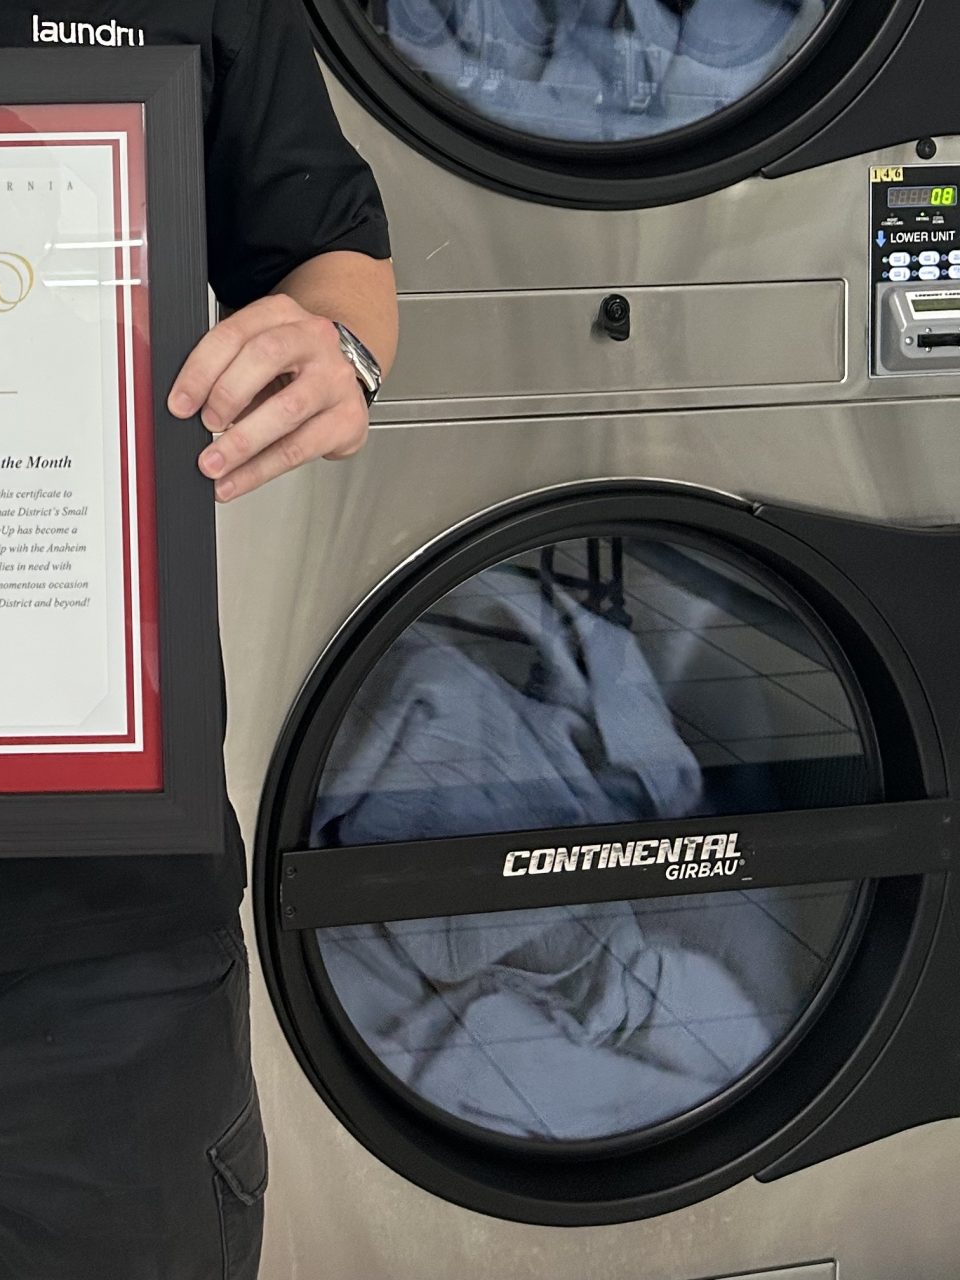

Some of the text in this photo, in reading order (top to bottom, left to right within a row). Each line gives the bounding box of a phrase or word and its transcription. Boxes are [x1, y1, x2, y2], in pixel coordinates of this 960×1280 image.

[931, 188, 954, 205] 08
[890, 230, 956, 243] LOWER UNIT
[1, 456, 22, 468] the
[26, 456, 71, 468] Month
[16, 489, 61, 500] certificate
[62, 507, 87, 516] Small
[17, 525, 32, 534] has
[35, 525, 69, 534] become
[31, 544, 44, 552] the
[47, 543, 86, 552] Anaheim
[28, 561, 50, 570] need
[52, 562, 71, 570] with
[34, 598, 52, 607] and
[54, 598, 90, 609] beyond!
[502, 832, 741, 877] CONTINENTAL
[665, 859, 738, 880] GIRBAU
